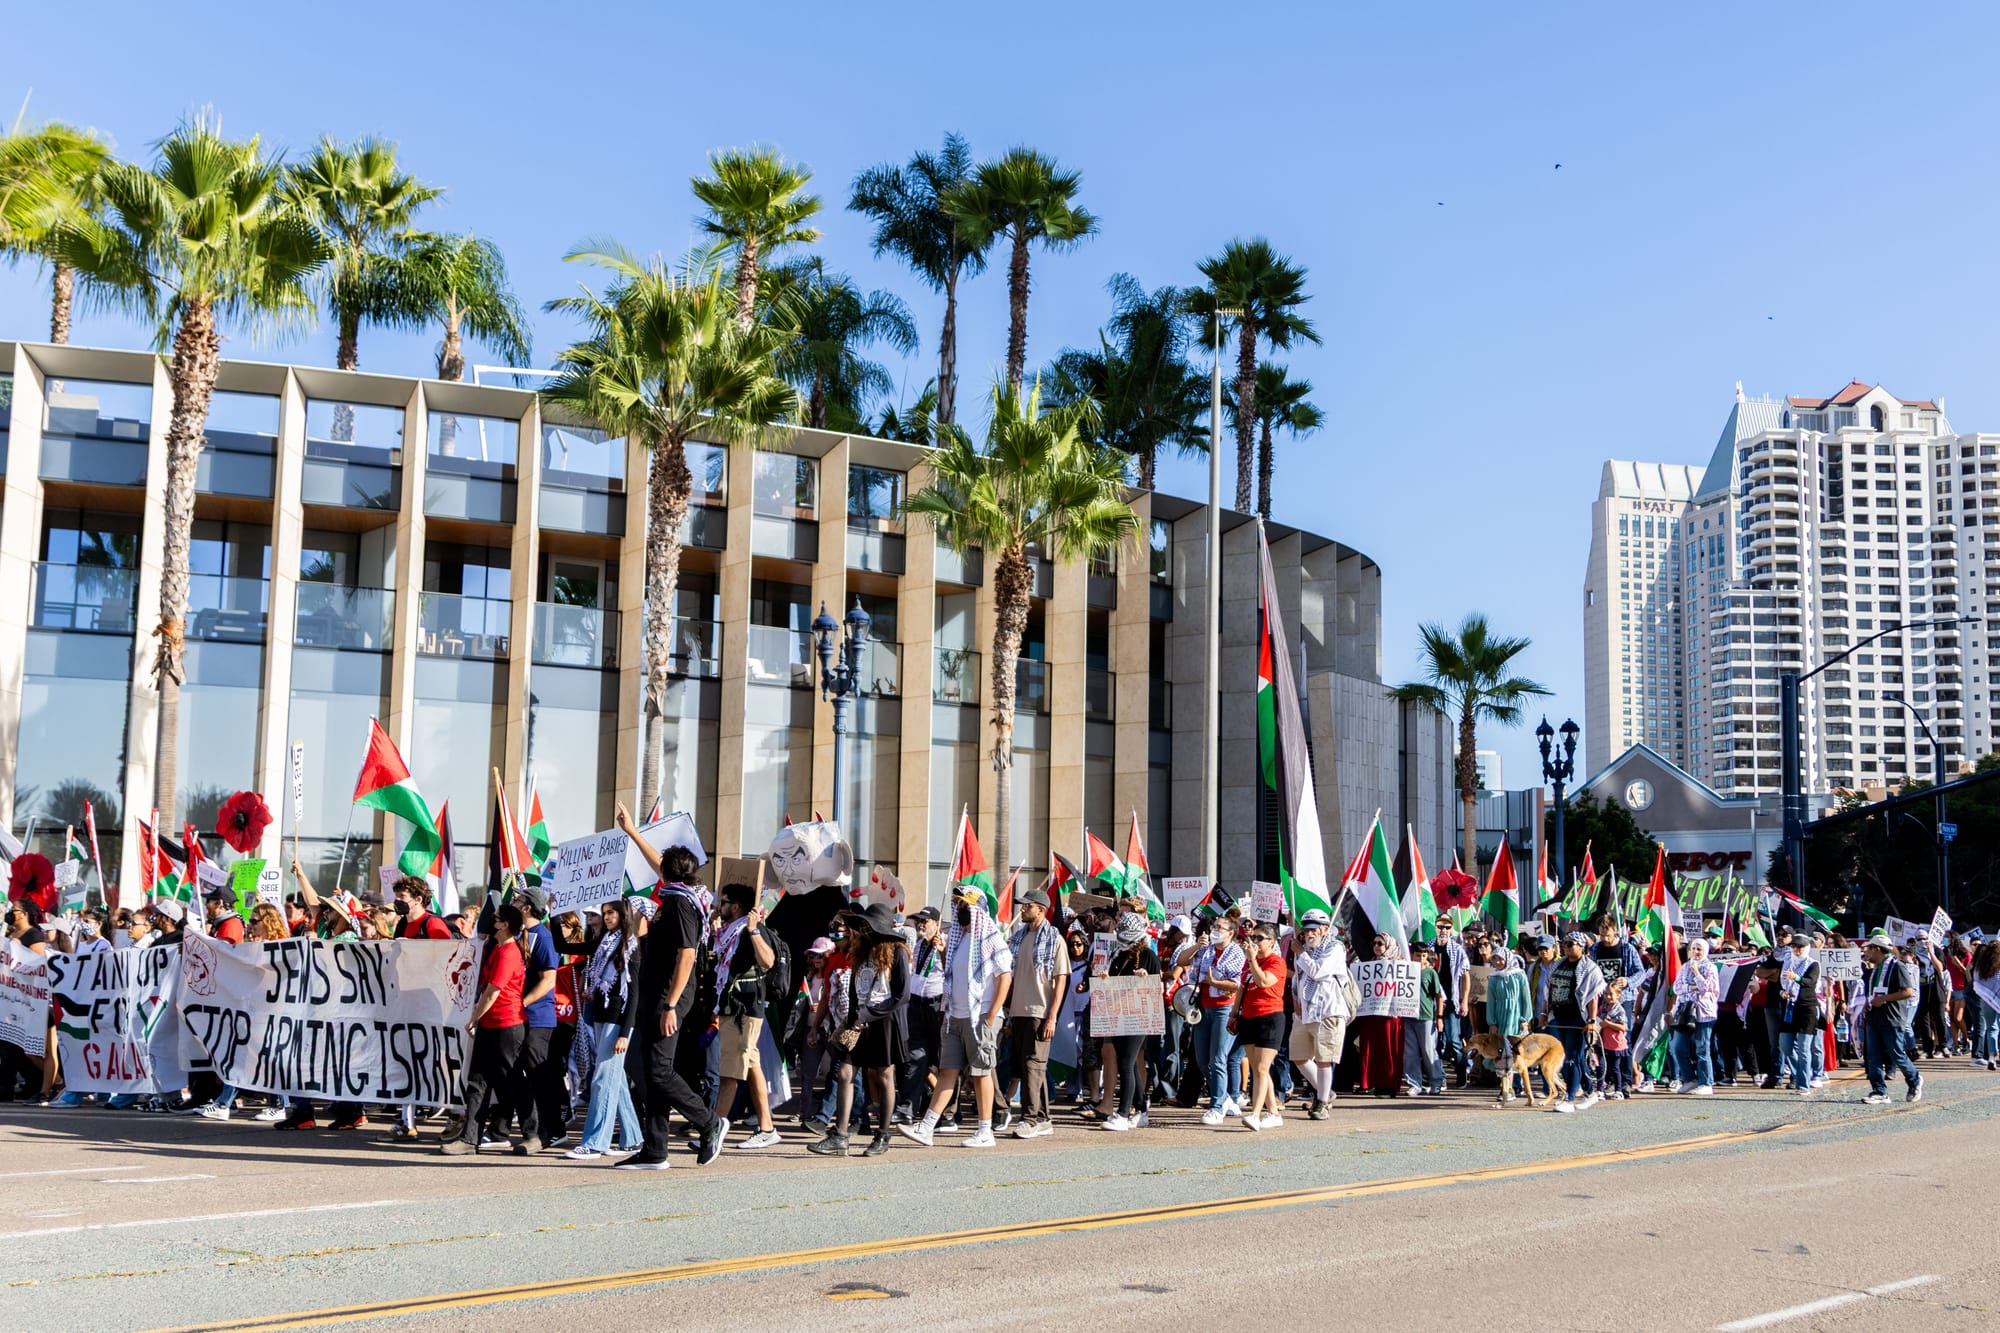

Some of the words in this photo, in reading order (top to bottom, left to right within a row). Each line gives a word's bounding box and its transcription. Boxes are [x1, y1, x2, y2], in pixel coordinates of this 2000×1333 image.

[1633, 501, 1675, 513] HYATT
[559, 844, 594, 867] KILLING
[599, 835, 628, 858] BABIES
[1669, 851, 1752, 871] EPOT
[261, 871, 279, 880] ND
[570, 868, 583, 883] IS
[588, 862, 610, 878] NOT
[260, 883, 279, 892] SIEGE
[553, 879, 621, 910] SELF-DEFENSE
[1167, 881, 1182, 889] FREE
[1184, 880, 1202, 888] GAZA
[1167, 901, 1182, 909] STOP
[1676, 875, 1759, 925] ENOCIDE
[1820, 951, 1851, 962] FREE
[47, 950, 129, 991] STAN
[137, 948, 169, 987] UP
[264, 940, 330, 1005] JEWS
[334, 943, 395, 1006] SAY:
[1357, 963, 1416, 981] ISRAEL
[1826, 966, 1861, 978] ESTINE
[1363, 981, 1415, 998] BOMBS
[1090, 987, 1161, 1016] GUILTY
[91, 997, 130, 1034] FO
[183, 1004, 251, 1080] STOP
[252, 1014, 369, 1096] ARMING
[374, 1021, 468, 1105] ISRAEL
